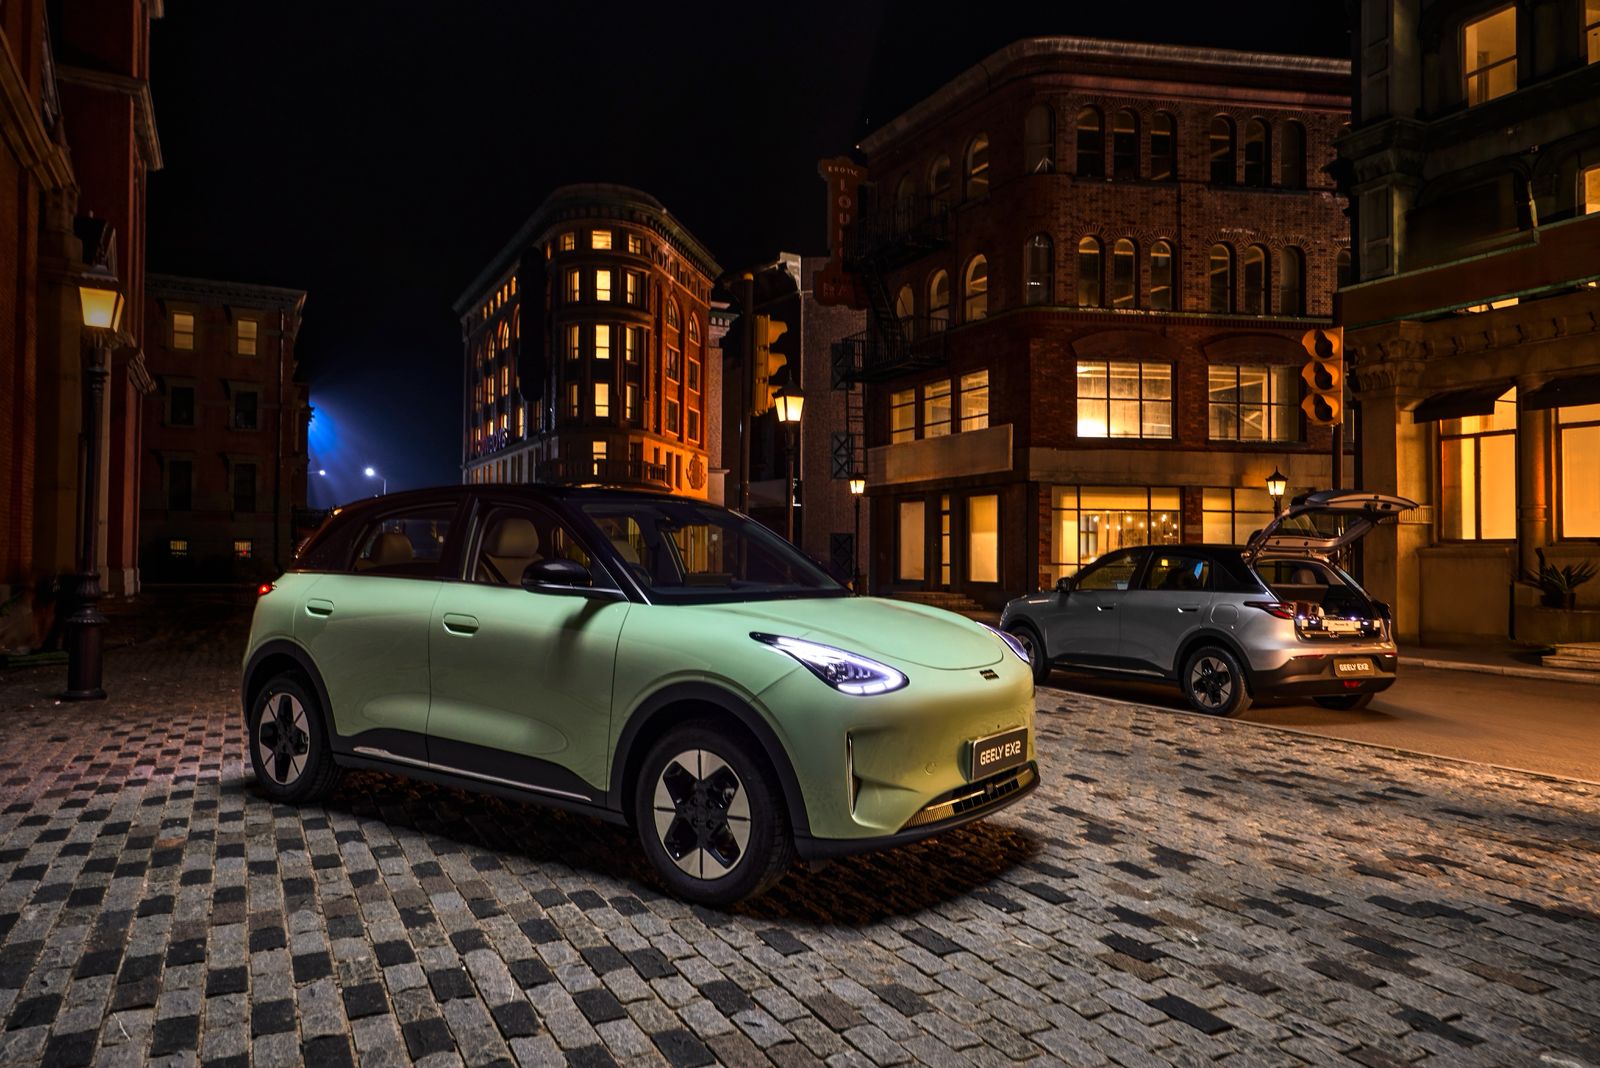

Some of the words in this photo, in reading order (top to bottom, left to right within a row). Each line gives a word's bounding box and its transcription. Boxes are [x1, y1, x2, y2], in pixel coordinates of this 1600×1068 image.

[1339, 663, 1356, 672] GEELY
[1357, 662, 1369, 671] EX2
[980, 744, 1004, 766] GEELY
[1005, 740, 1021, 757] EX2
